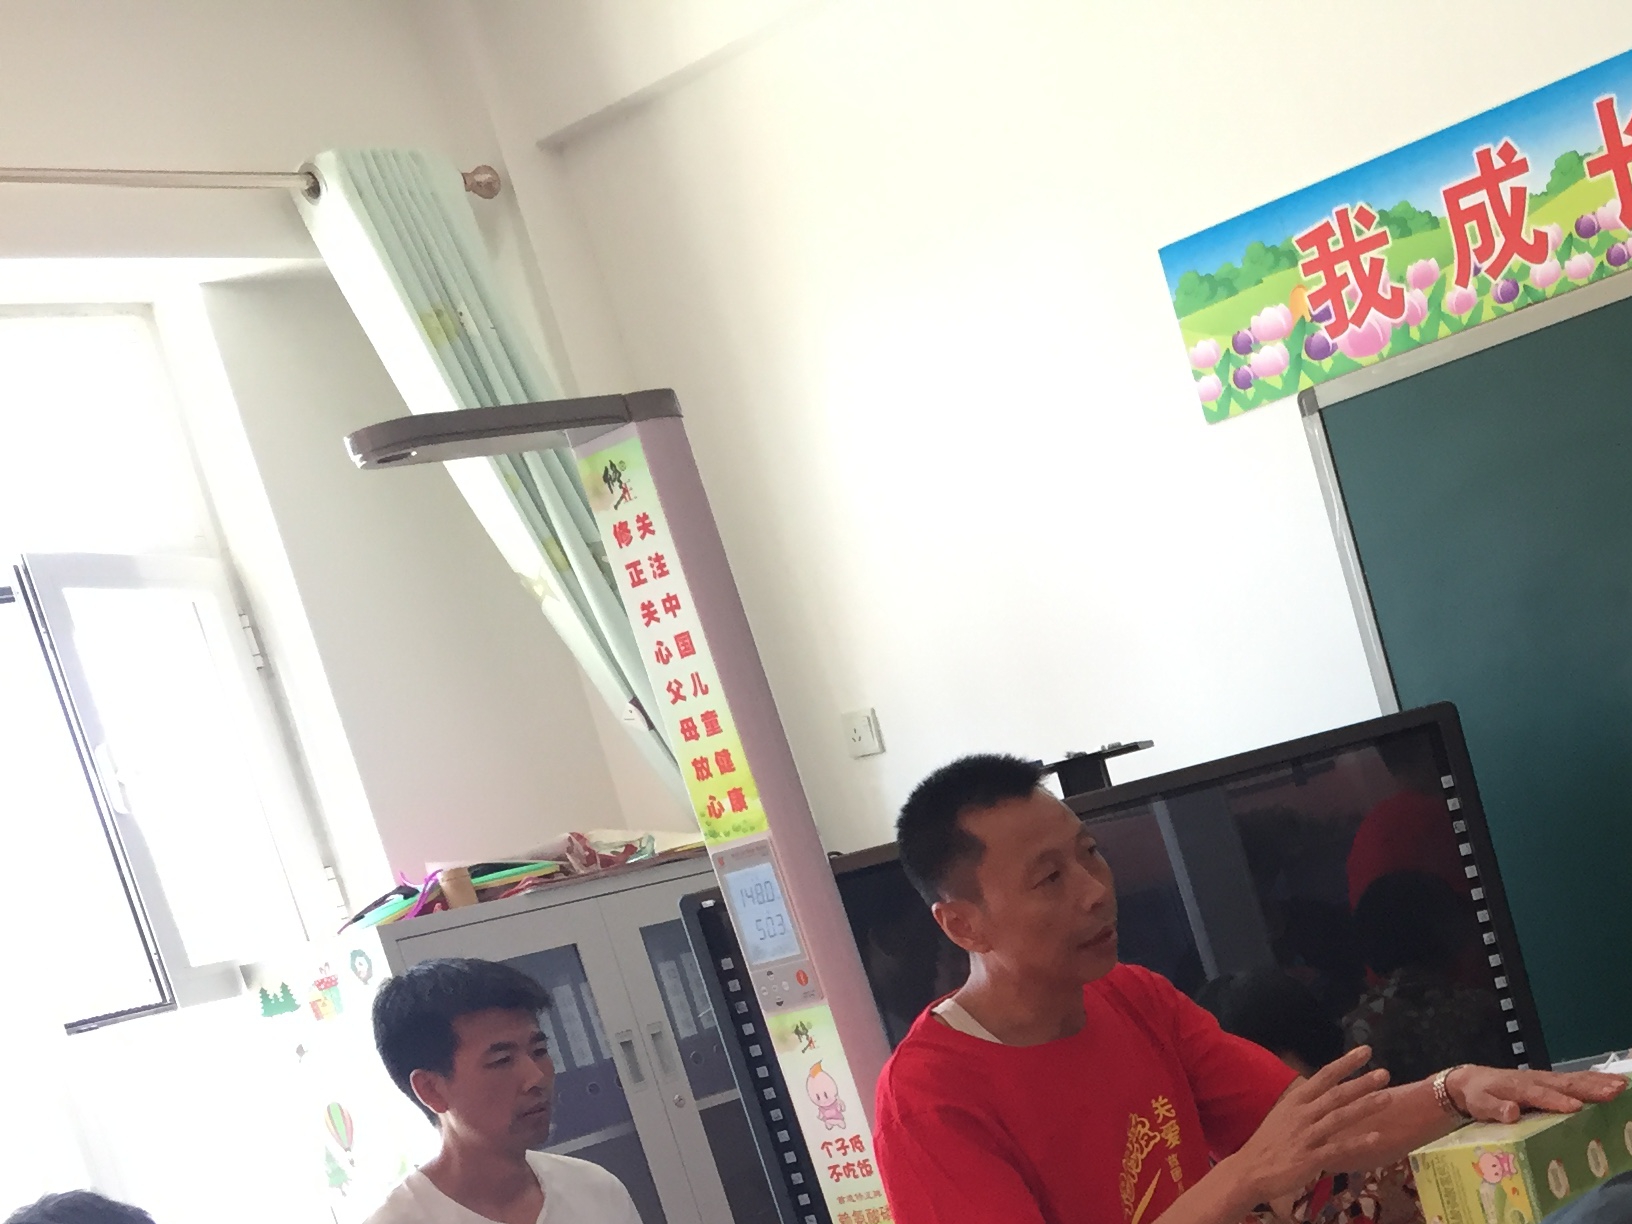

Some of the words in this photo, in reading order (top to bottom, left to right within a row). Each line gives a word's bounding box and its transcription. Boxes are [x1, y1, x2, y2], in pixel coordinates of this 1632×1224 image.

[612, 520, 726, 820] 修正关心父母放心
[635, 511, 749, 814] 关注中国儿童健康
[827, 1158, 874, 1183] 不吃饭
[1151, 1095, 1181, 1149] 关爱
